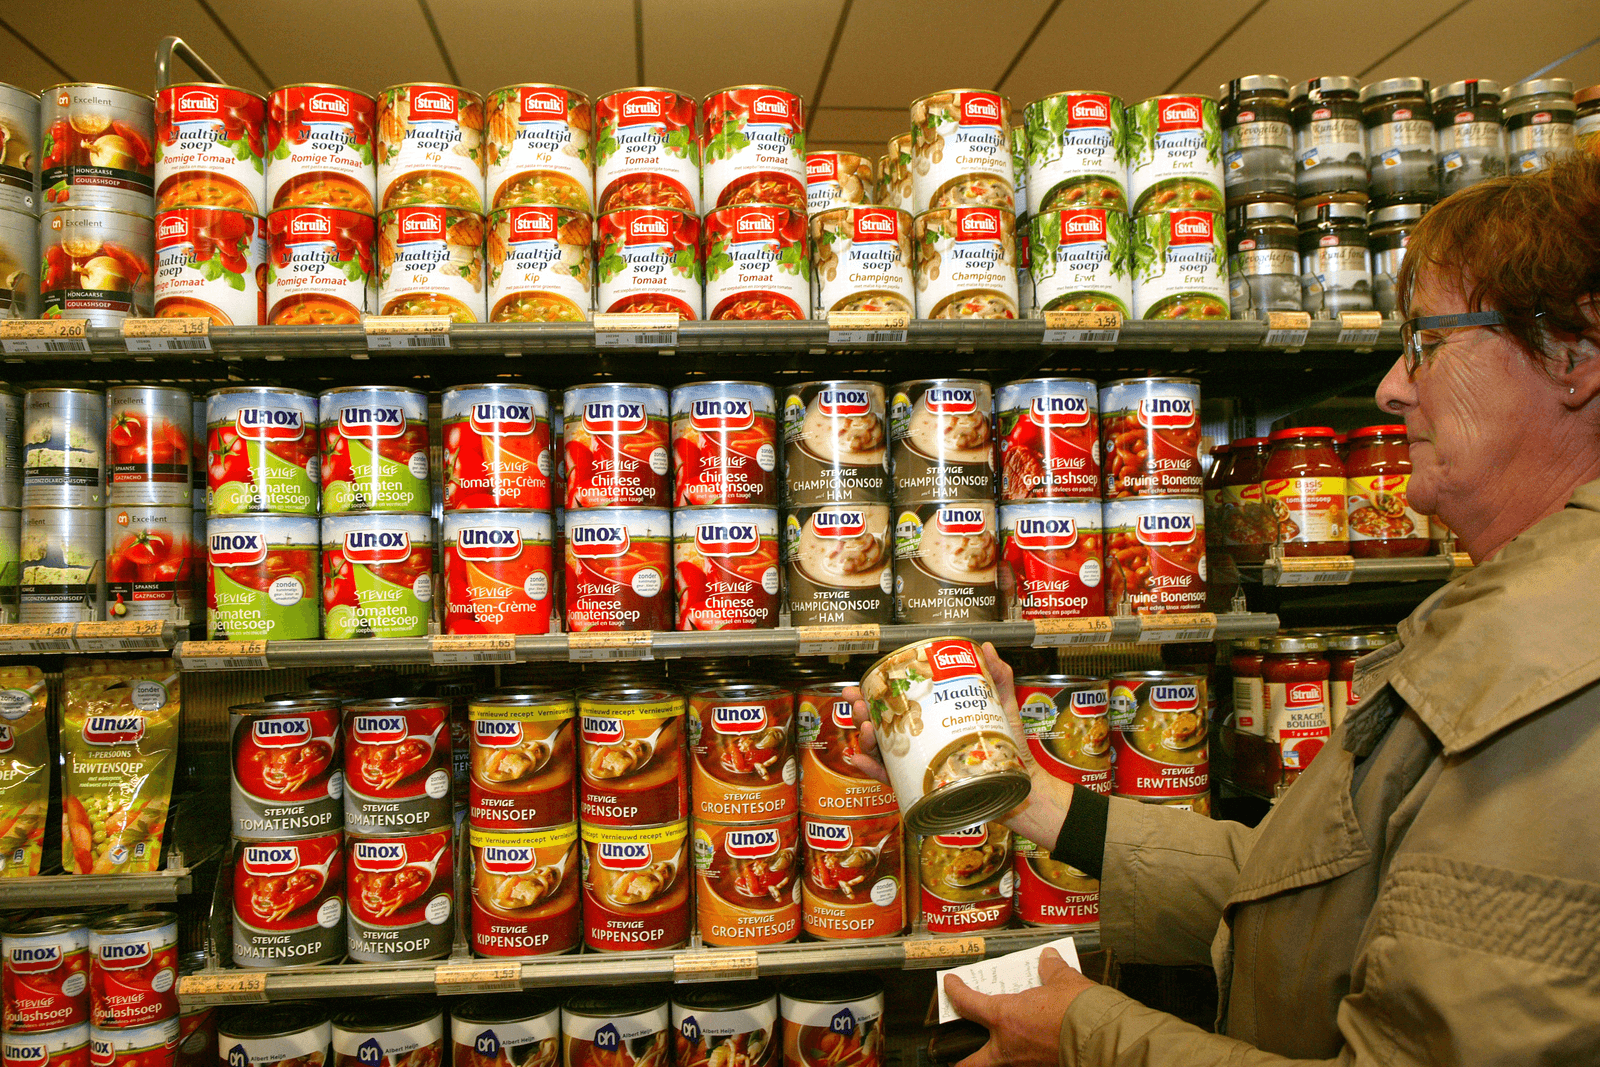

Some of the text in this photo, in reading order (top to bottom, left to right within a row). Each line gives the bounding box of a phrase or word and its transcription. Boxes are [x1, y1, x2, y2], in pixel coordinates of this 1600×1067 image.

[74, 96, 112, 106] Excellent
[404, 129, 462, 142] Maaltijd
[955, 134, 1005, 146] Maaltijd
[417, 141, 449, 151] soep
[969, 145, 996, 155] soep
[164, 153, 235, 164] Romige Tomaat
[292, 155, 363, 168] Romige Tomaat
[426, 152, 441, 163] Kip
[536, 152, 551, 163] Kip
[625, 156, 659, 165] Tomaat
[756, 154, 788, 164] Tomaat
[956, 155, 1006, 168] Champignon
[1082, 159, 1102, 167] Erwt
[1173, 160, 1193, 169] Erwt
[76, 178, 120, 186] GOULASHSOEP
[66, 218, 102, 228] Excellent
[282, 252, 340, 263] Maaltijd
[622, 253, 677, 264] Maaltijd
[849, 251, 901, 262] Maaltijd
[1166, 252, 1217, 263] Maaltijd
[293, 263, 325, 274] soep
[634, 264, 664, 274] soep
[863, 262, 892, 272] soep
[1179, 263, 1207, 273] soep
[277, 276, 346, 287] Romige Tomaat
[413, 275, 428, 285] Kip
[632, 276, 667, 285] Tomaat
[738, 274, 773, 283] Tomaat
[849, 273, 903, 285] Champignon
[952, 272, 1006, 284] Champignon
[1184, 275, 1204, 283] Erwt
[60, 326, 81, 335] 2,60
[932, 487, 958, 498] HAM
[817, 513, 860, 525] unox
[943, 510, 982, 522] unox
[1020, 519, 1071, 534] unox
[1143, 516, 1191, 530] unox
[463, 529, 515, 545] unox
[574, 527, 622, 542] unox
[701, 526, 753, 541] unox
[212, 535, 258, 550] unox
[350, 532, 404, 548] unox
[706, 582, 752, 593] STEVIGE
[1023, 580, 1070, 590] STEVIGE
[354, 590, 403, 601] STEVIGE
[466, 587, 513, 598] STEVIGE
[814, 591, 850, 599] STEVIGE
[938, 588, 974, 596] STEVIGE
[450, 602, 537, 613] Tomaten-Crème
[577, 599, 621, 610] Chinese
[705, 597, 754, 609] Chinese
[792, 600, 880, 612] CHAMPIGNONSOEP
[908, 596, 995, 608] CHAMPIGNONSOEP
[350, 606, 407, 617] Tomaten
[691, 608, 768, 619] Tomatensoep
[944, 609, 969, 619] HAM
[340, 615, 418, 629] Groentesoep
[475, 613, 503, 624] soep
[819, 612, 844, 623] HAM
[1088, 621, 1108, 630] 1,65
[240, 645, 261, 654] 1,65
[934, 685, 994, 704] Maaltijd
[1156, 687, 1195, 699] unox
[955, 699, 987, 711] soep
[717, 707, 761, 721] unox
[942, 711, 1004, 728] Champignon
[1291, 713, 1323, 721] KRACHT
[91, 717, 138, 731] unox
[258, 721, 305, 735] unox
[477, 721, 516, 734] unox
[1287, 720, 1326, 728] BOUILLON
[89, 750, 131, 758] 1-PERSOONS
[73, 762, 144, 774] ERWTENSOEP
[1162, 767, 1195, 776] STEVIGE
[1137, 774, 1208, 788] ERWTENSOEP
[724, 792, 761, 801] STEVIGE
[264, 806, 305, 816] STEVIGE
[701, 799, 786, 814] GROENTESOEP
[240, 812, 332, 831] TOMATENSOEP
[601, 832, 662, 841] Vernieuwd recept
[809, 824, 846, 838] unox
[523, 836, 546, 844] recept
[732, 831, 774, 845] unox
[248, 848, 293, 862] unox
[487, 848, 529, 861] unox
[603, 843, 646, 857] unox
[876, 882, 894, 890] zonder
[814, 907, 845, 916] STEVIGE
[491, 925, 528, 933] STEVIGE
[712, 919, 795, 938] GROENTESOEP
[477, 933, 549, 948] KIPPENSOEP
[592, 928, 665, 943] KIPPENSOEP
[13, 947, 57, 961] unox
[102, 943, 146, 958] unox
[960, 944, 979, 954] 1,45
[239, 980, 260, 991] 1,53
[93, 1002, 162, 1019] Goulashsoep
[5, 1044, 42, 1058] unox
